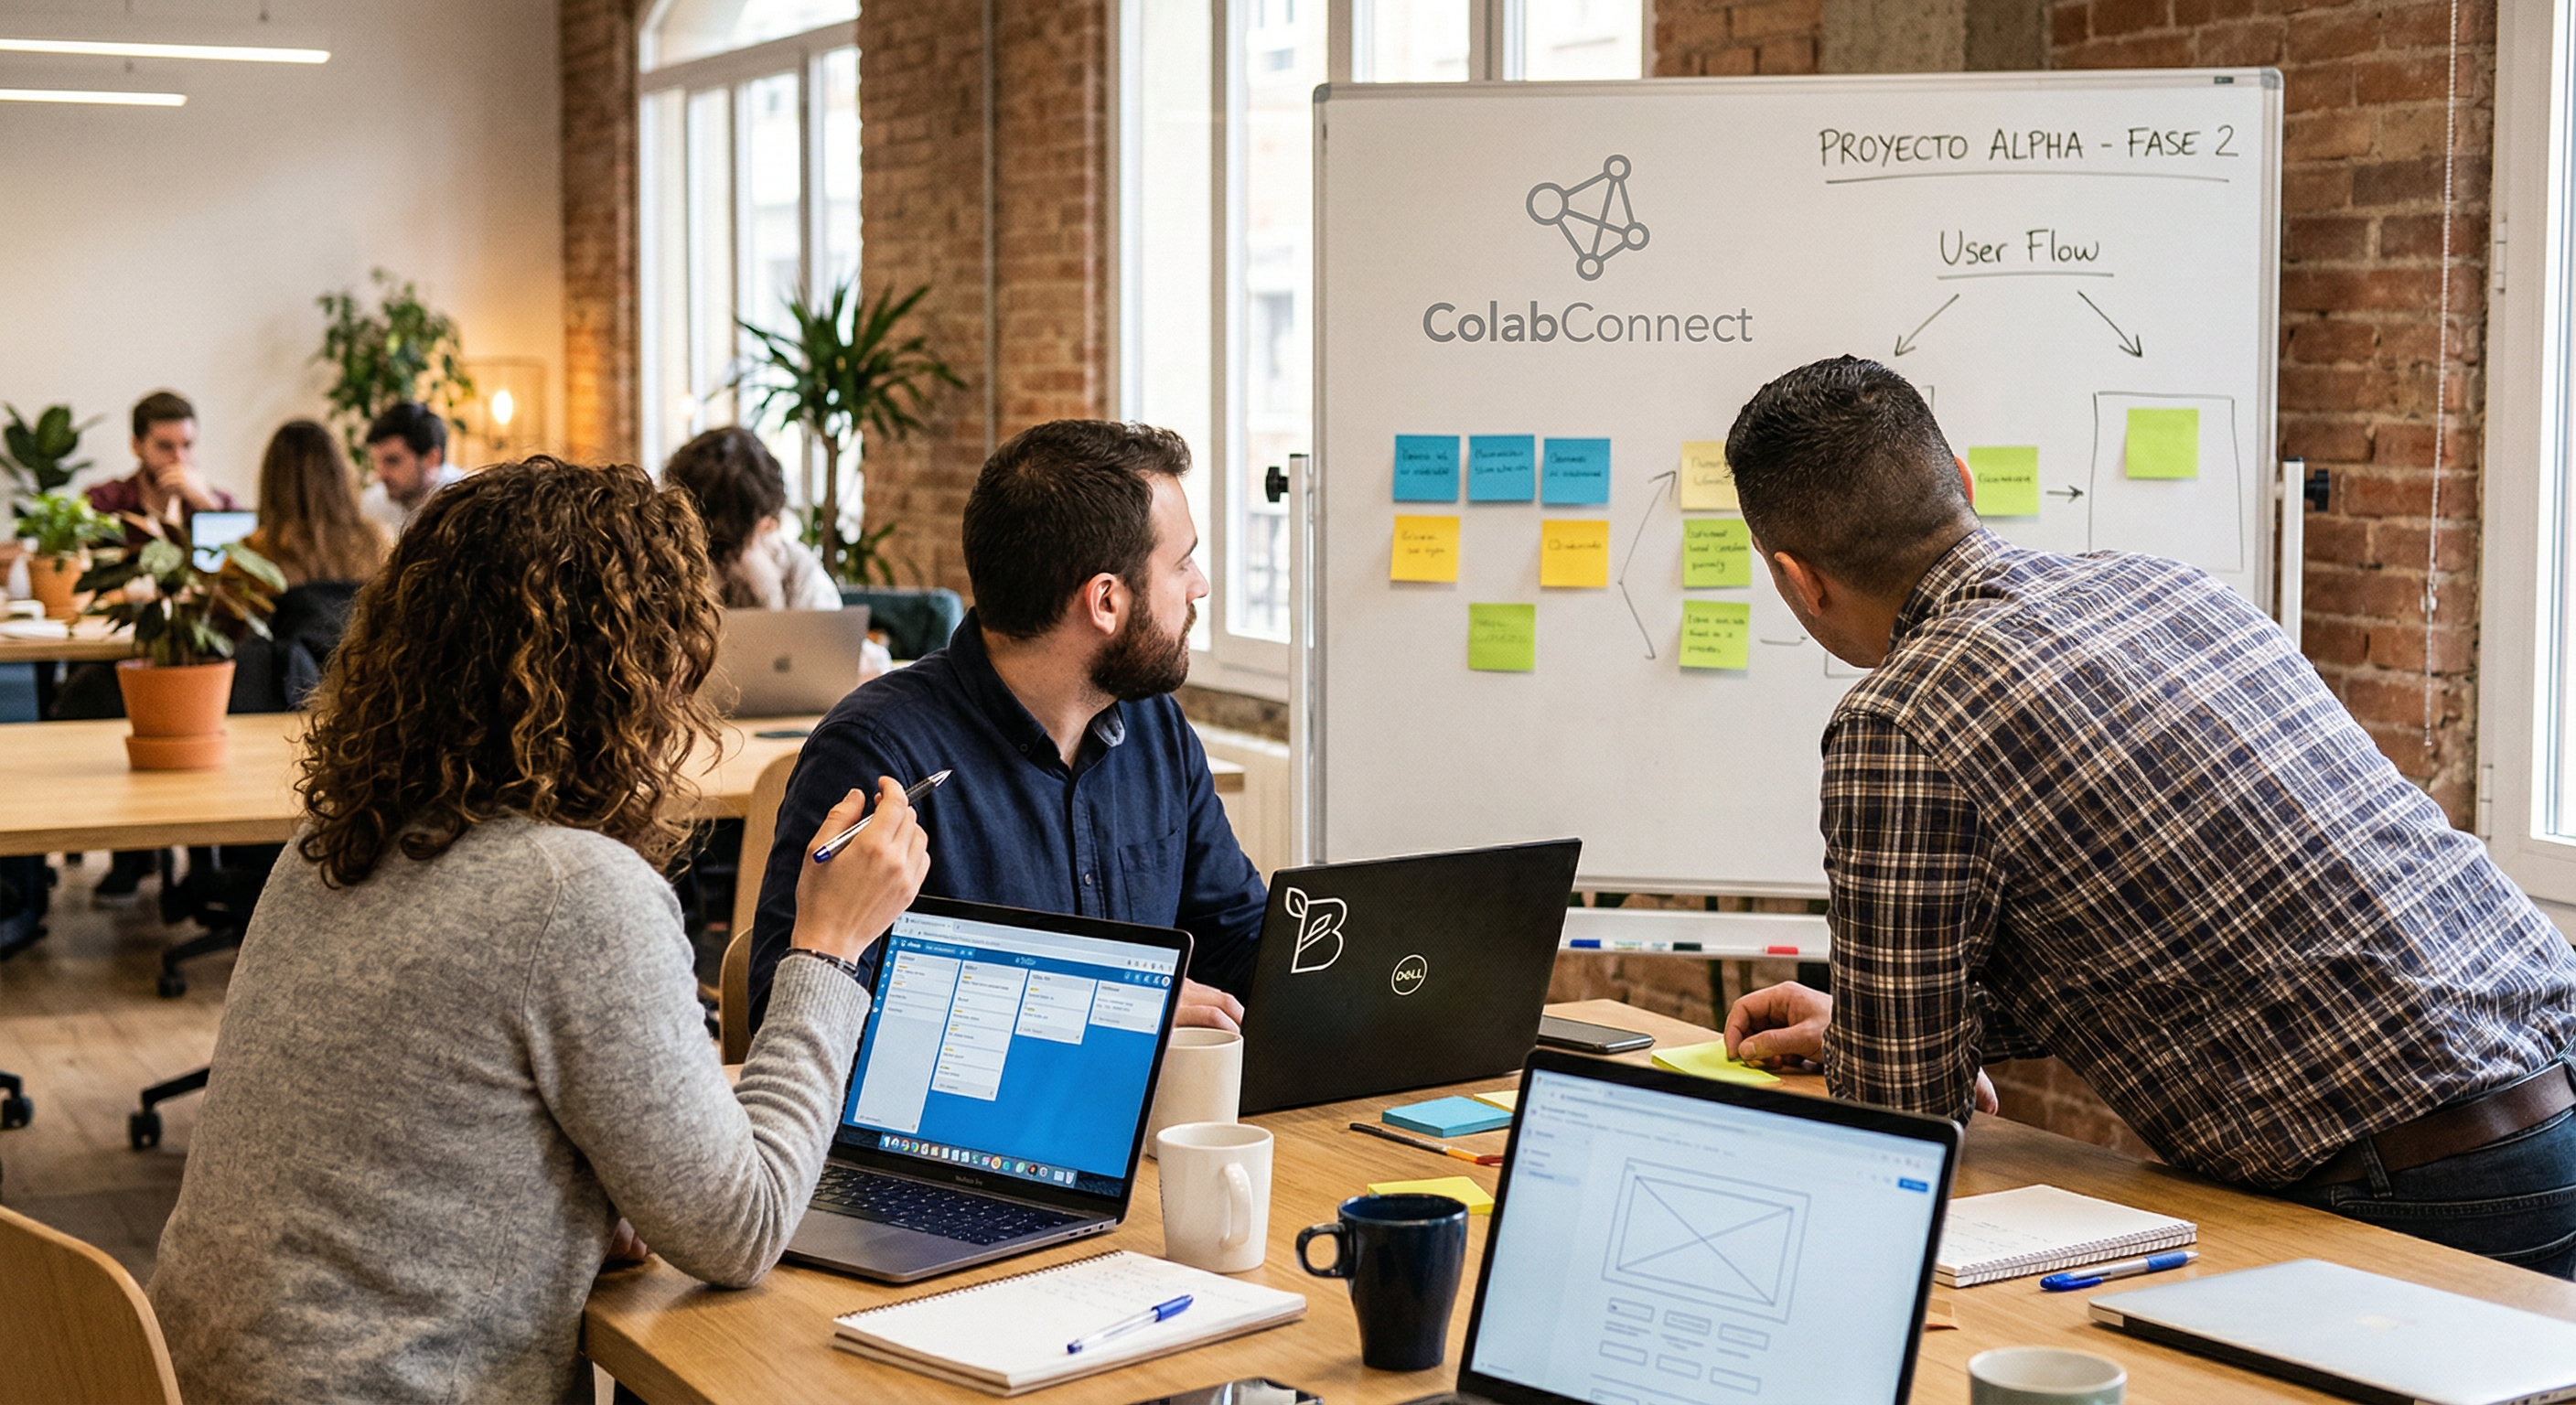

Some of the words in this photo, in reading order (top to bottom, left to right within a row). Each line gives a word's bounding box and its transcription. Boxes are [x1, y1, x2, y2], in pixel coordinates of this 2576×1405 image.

[1819, 128, 1969, 167] PROYECTO
[1988, 127, 2084, 161] ALPHA
[2127, 126, 2202, 158] FASE
[2214, 124, 2240, 158] 2
[1939, 229, 2009, 266] User
[2025, 228, 2100, 263] Flow
[1422, 300, 1754, 343] ColabConnect
[1395, 968, 1423, 981] DELL
